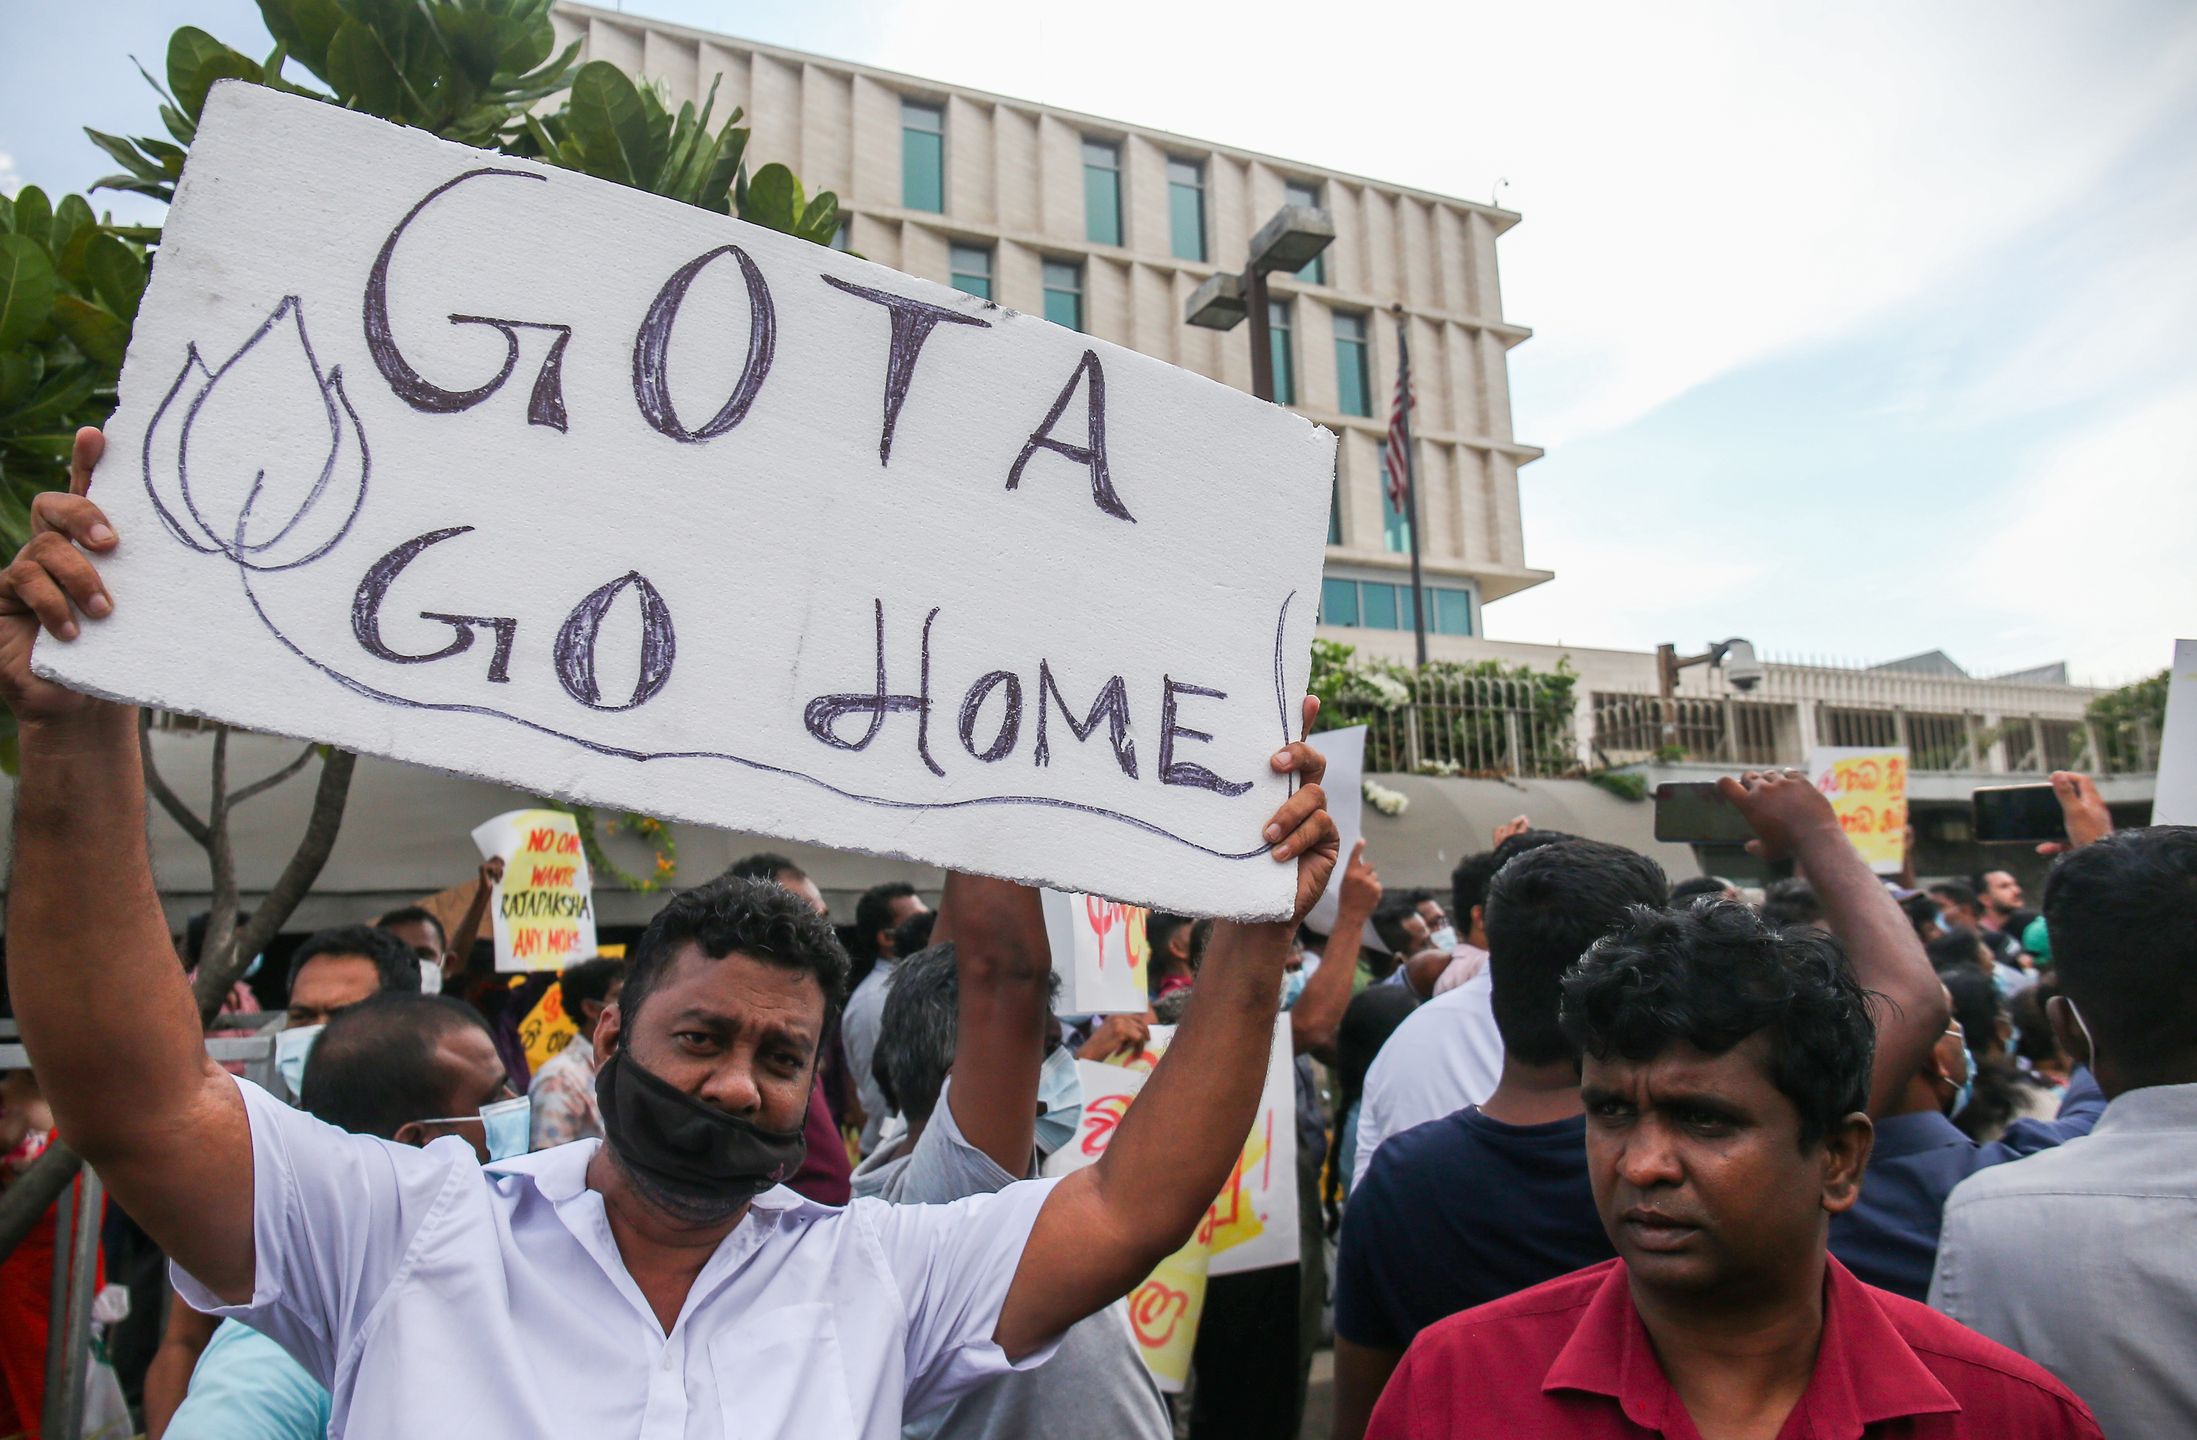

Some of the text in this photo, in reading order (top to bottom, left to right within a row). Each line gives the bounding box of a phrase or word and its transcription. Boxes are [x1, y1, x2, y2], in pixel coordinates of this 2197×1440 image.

[351, 525, 677, 713] GO
[527, 828, 555, 852] NO
[499, 889, 592, 921] RAJAPAKSHA
[512, 926, 545, 959] ANY
